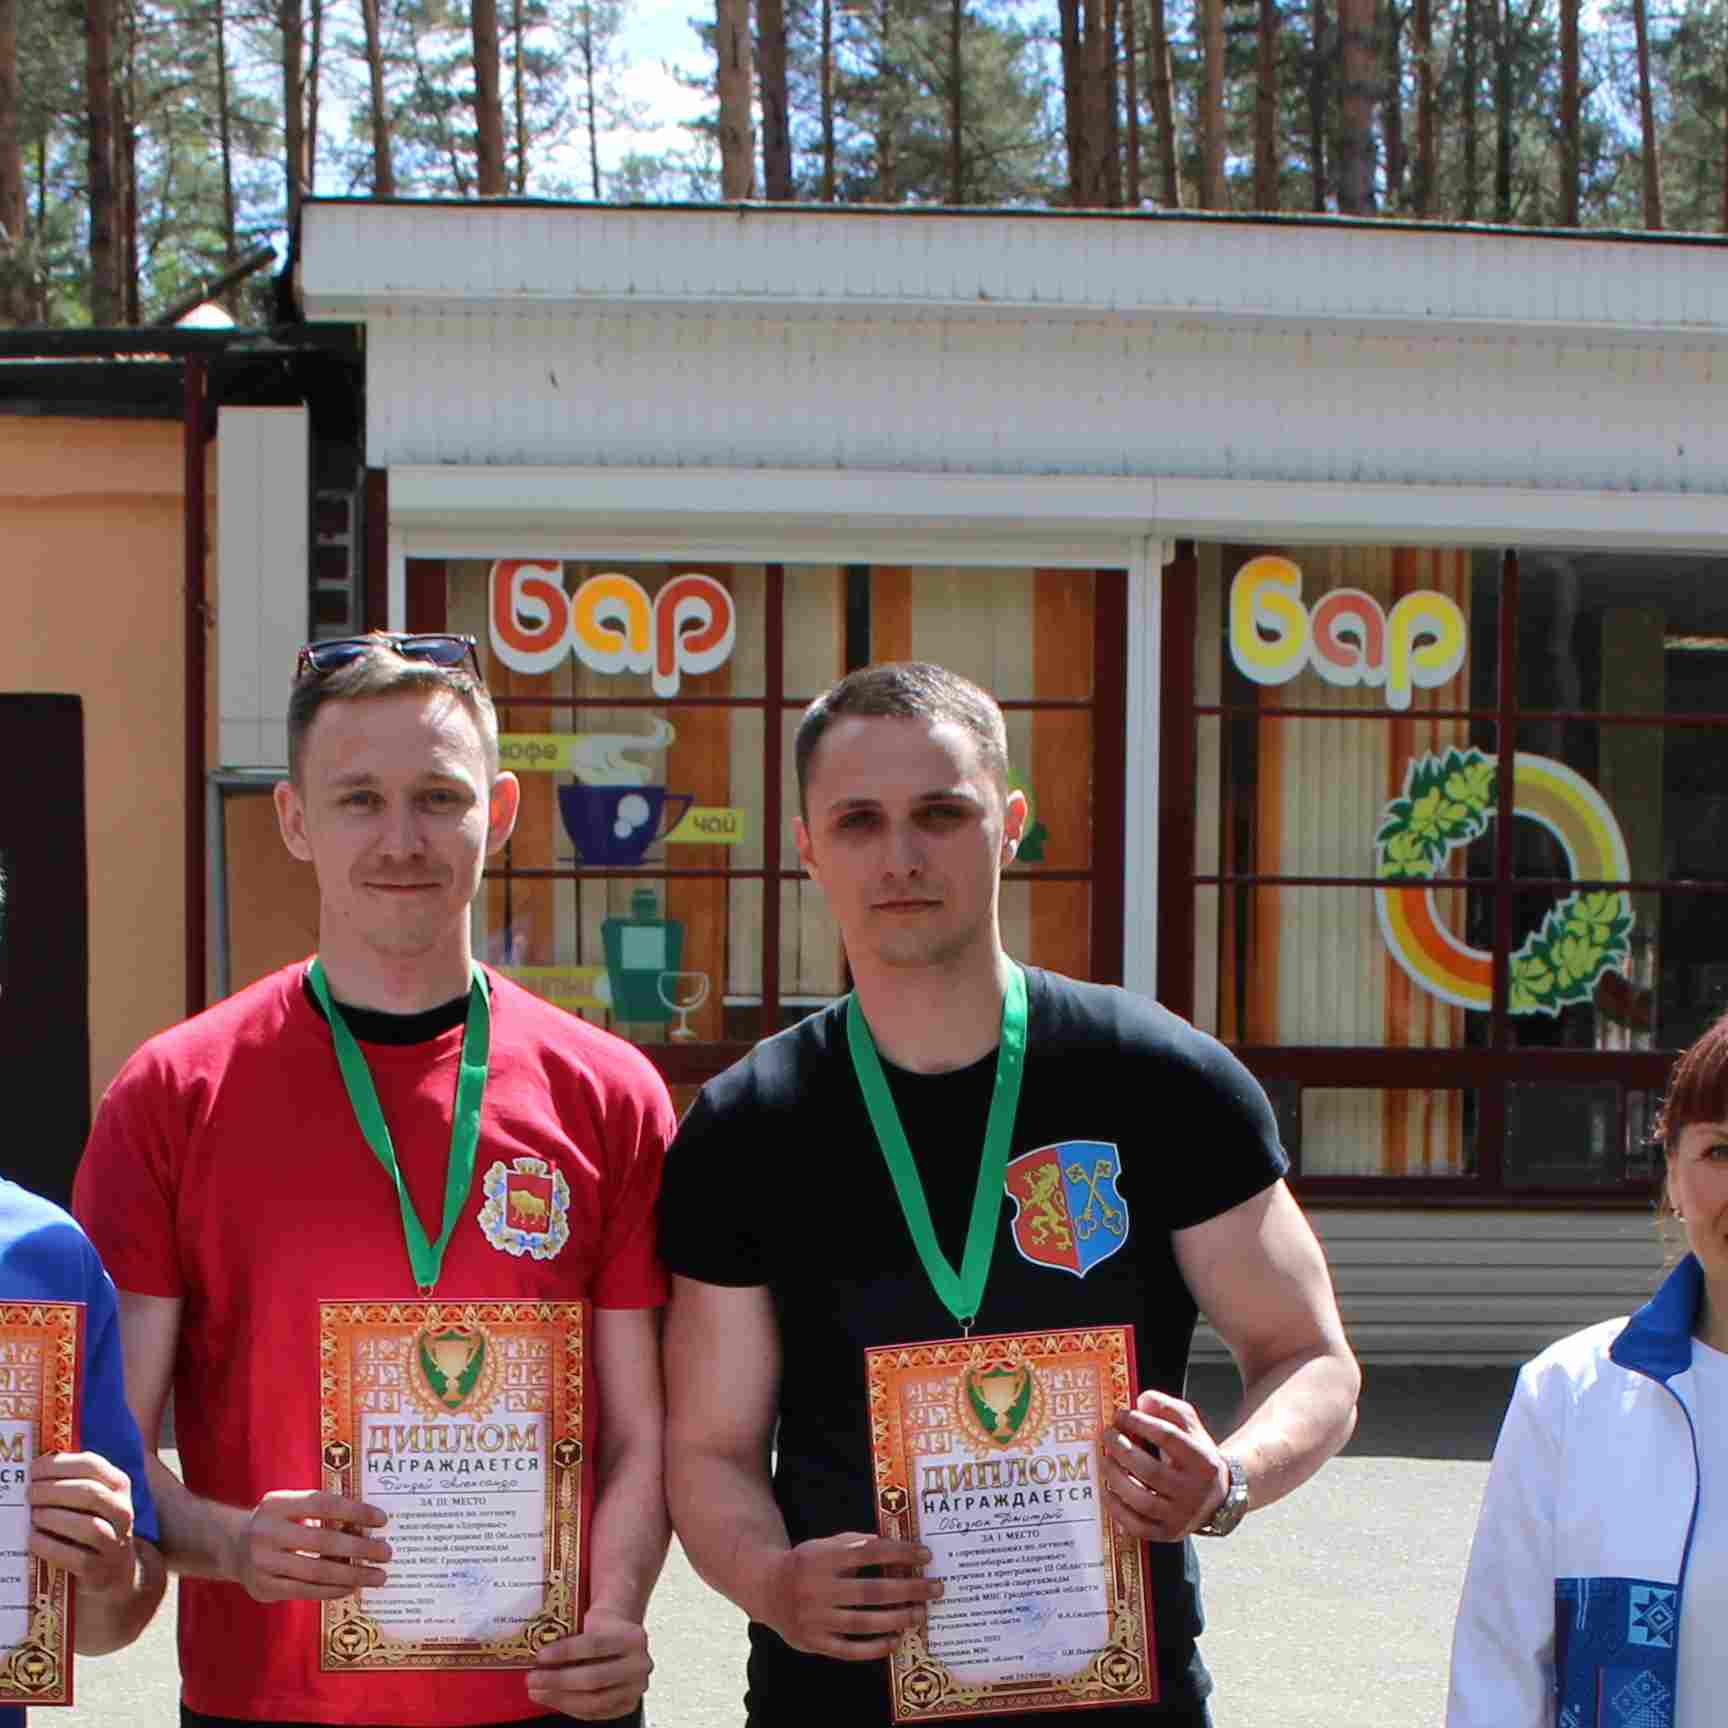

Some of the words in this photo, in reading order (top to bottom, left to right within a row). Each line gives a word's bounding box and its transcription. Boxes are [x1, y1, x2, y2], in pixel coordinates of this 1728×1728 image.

[489, 560, 735, 697] бар
[1229, 554, 1467, 709] бар
[692, 813, 736, 834] чай
[367, 1423, 540, 1457] ДИПЛОМ
[368, 1458, 539, 1474] НАГРАЖДАЕТСЯ
[922, 1454, 1091, 1497] ДИПЛОМ
[452, 1497, 487, 1506] МЕСТО
[923, 1486, 1093, 1513] НАГРАЖДАЕТСЯ
[1006, 1530, 1040, 1540] МЕСТО
